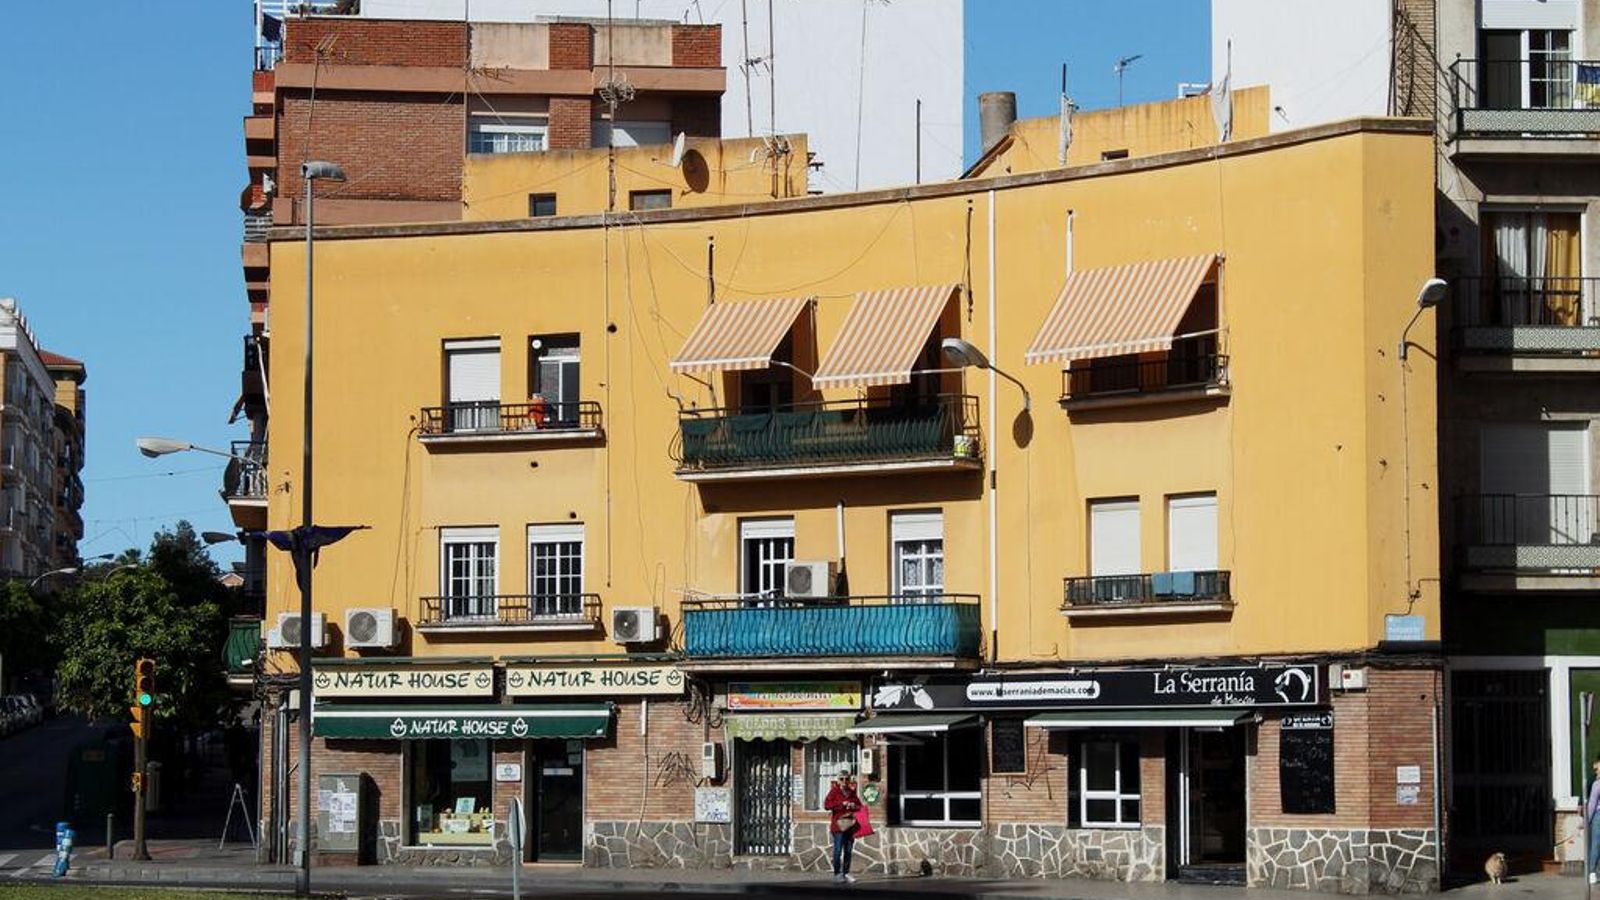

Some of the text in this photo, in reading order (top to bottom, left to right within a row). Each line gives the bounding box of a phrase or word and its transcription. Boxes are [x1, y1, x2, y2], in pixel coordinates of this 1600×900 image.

[334, 672, 470, 689] NATUR HOUSE
[528, 670, 662, 686] NATUR HOUSE
[1154, 671, 1255, 694] La Serranía
[410, 719, 508, 734] NATUR HOUSE
